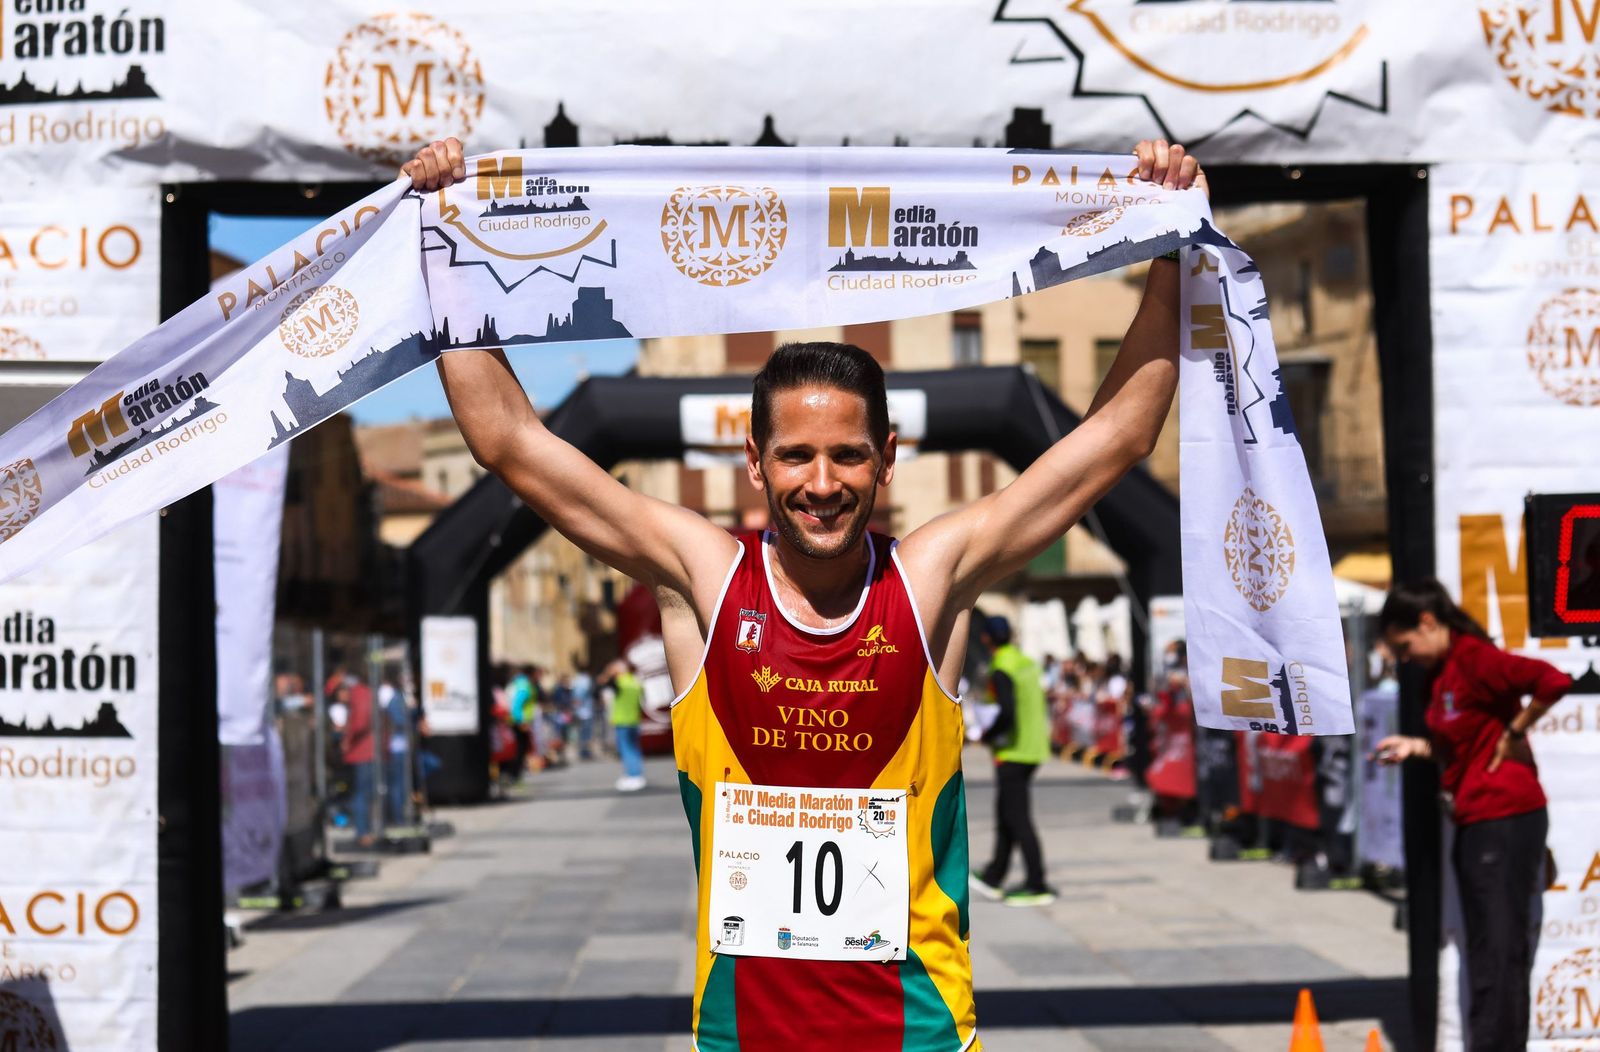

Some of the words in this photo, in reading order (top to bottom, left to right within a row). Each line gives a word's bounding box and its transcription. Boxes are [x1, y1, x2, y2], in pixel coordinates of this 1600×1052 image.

[1234, 8, 1341, 39] Rodrigo
[29, 109, 165, 147] Rodrigo
[478, 217, 529, 232] Ciudad
[533, 213, 591, 229] Rodrigo
[828, 273, 896, 291] Ciudad
[902, 273, 977, 289] Rodrigo
[88, 448, 155, 490] Ciudad
[155, 411, 228, 455] Rodrigo
[785, 677, 824, 692] CAJA
[827, 679, 879, 692] RURAL
[777, 705, 849, 728] VINO
[752, 726, 787, 747] DE
[794, 731, 873, 751] TORO
[733, 789, 754, 806] XIV
[757, 791, 796, 809] Media
[800, 794, 853, 811] Maratón
[732, 812, 744, 824] de
[747, 809, 795, 828] Ciudad
[799, 812, 853, 833] Rodrigo
[873, 810, 896, 821] 2019
[719, 850, 760, 861] PALACIO
[786, 841, 843, 917] 10
